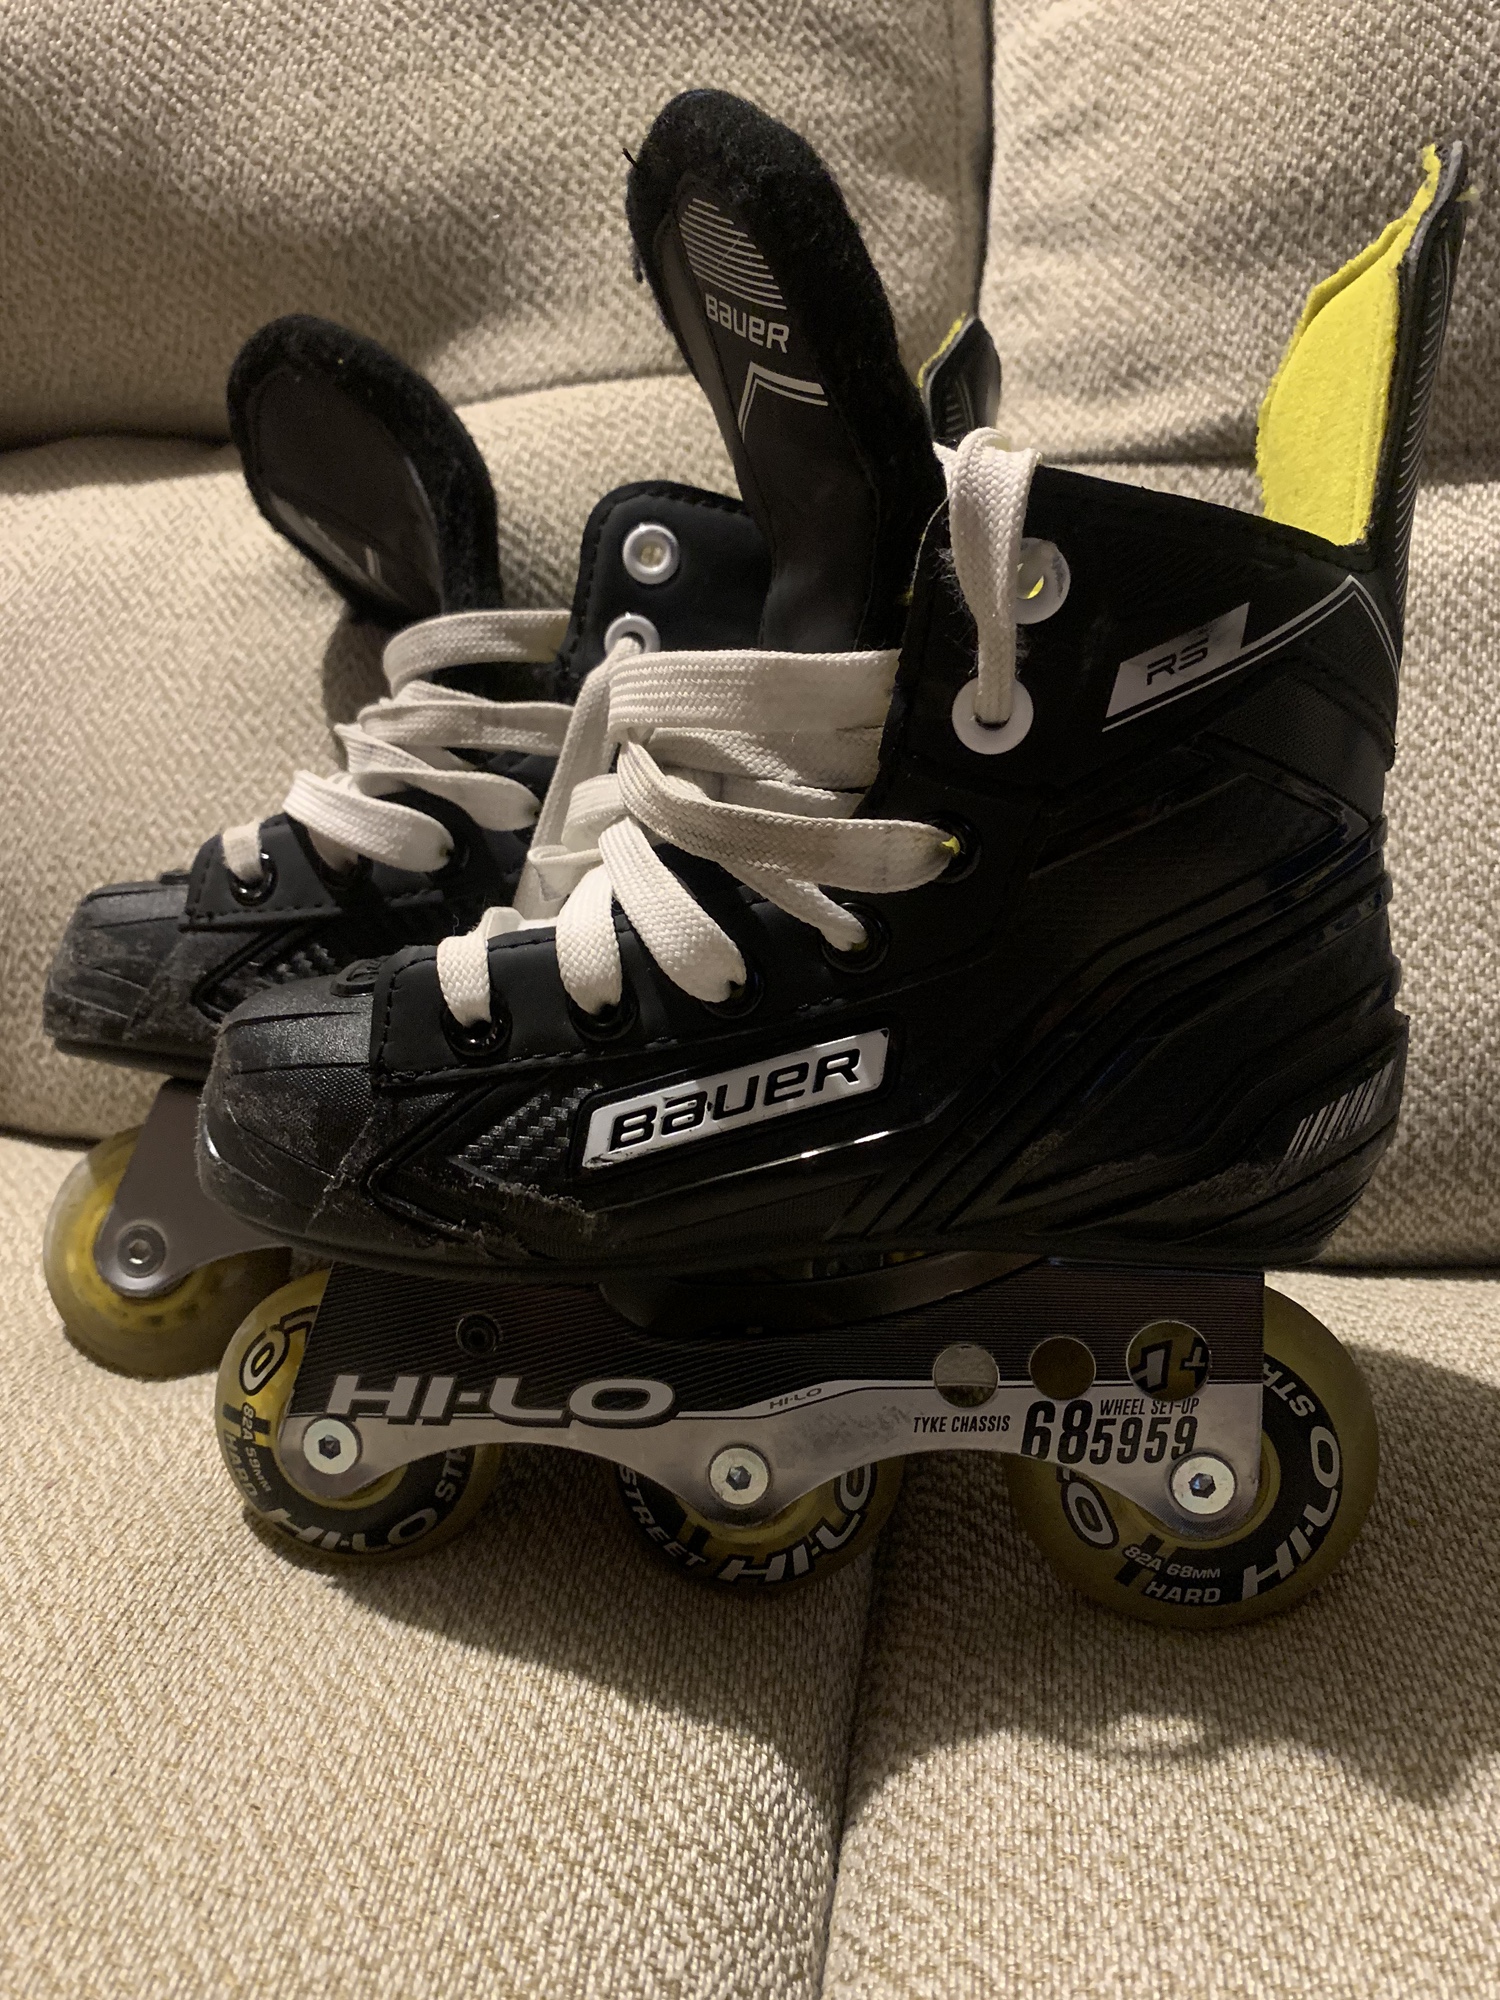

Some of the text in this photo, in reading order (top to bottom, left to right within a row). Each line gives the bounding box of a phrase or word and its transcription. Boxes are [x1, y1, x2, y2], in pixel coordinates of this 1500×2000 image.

[1146, 638, 1209, 686] RS
[326, 1374, 677, 1425] HI-LO
[769, 1388, 822, 1409] HI-LO
[1100, 1398, 1199, 1416] WHEEL SET-UP
[913, 1415, 1010, 1433] TYKE CHASSIS
[224, 1431, 258, 1497] HARD
[1241, 1362, 1341, 1601] HI-LO STR
[262, 1507, 438, 1552] HI-LO
[619, 1463, 871, 1583] STREET HI-LO
[1124, 1545, 1222, 1580] 82A 68MM
[1145, 1580, 1222, 1604] HARD
